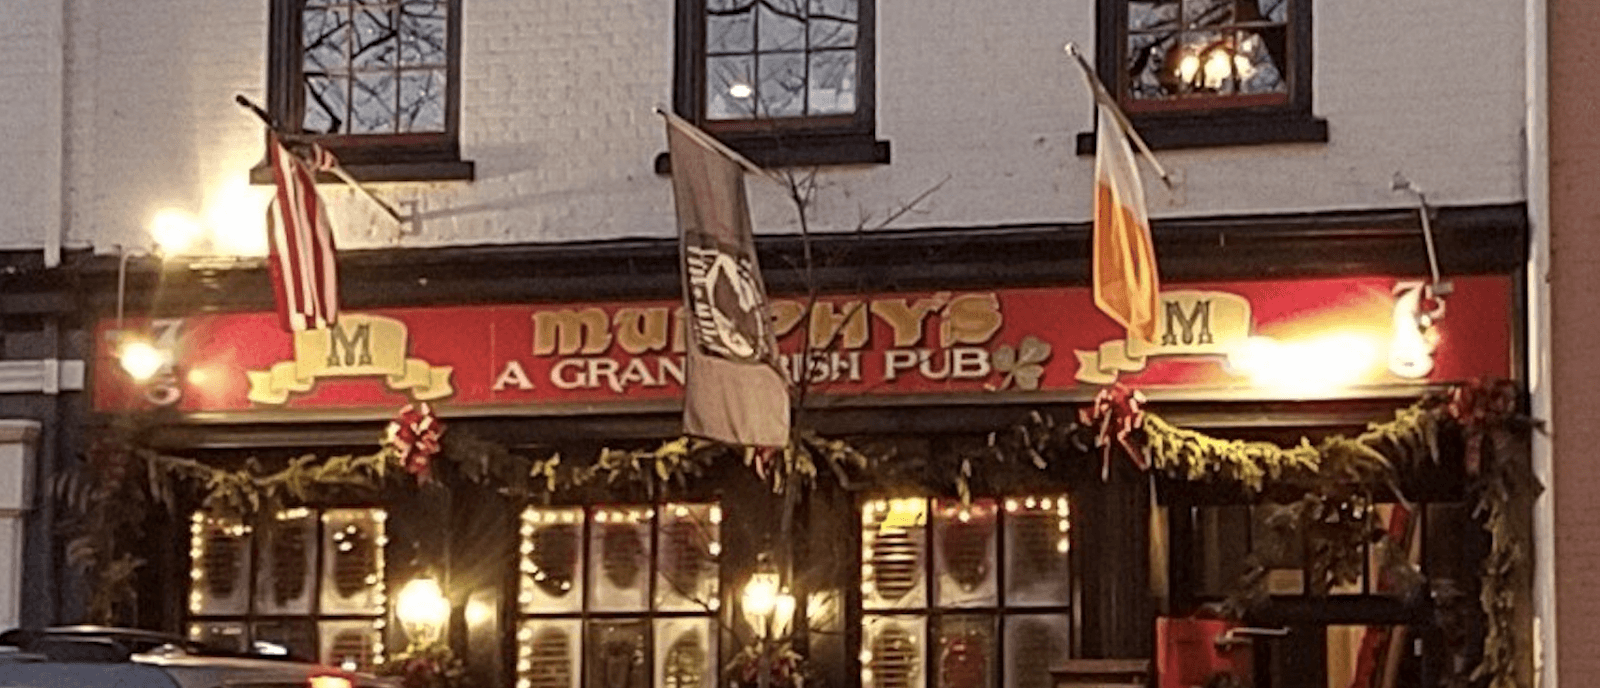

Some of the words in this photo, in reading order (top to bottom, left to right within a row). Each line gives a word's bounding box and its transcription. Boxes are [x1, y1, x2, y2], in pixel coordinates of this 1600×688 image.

[327, 322, 374, 367] M
[1161, 300, 1214, 346] M
[491, 360, 535, 391] A
[550, 355, 687, 393] GRAN
[884, 346, 991, 380] PUB
